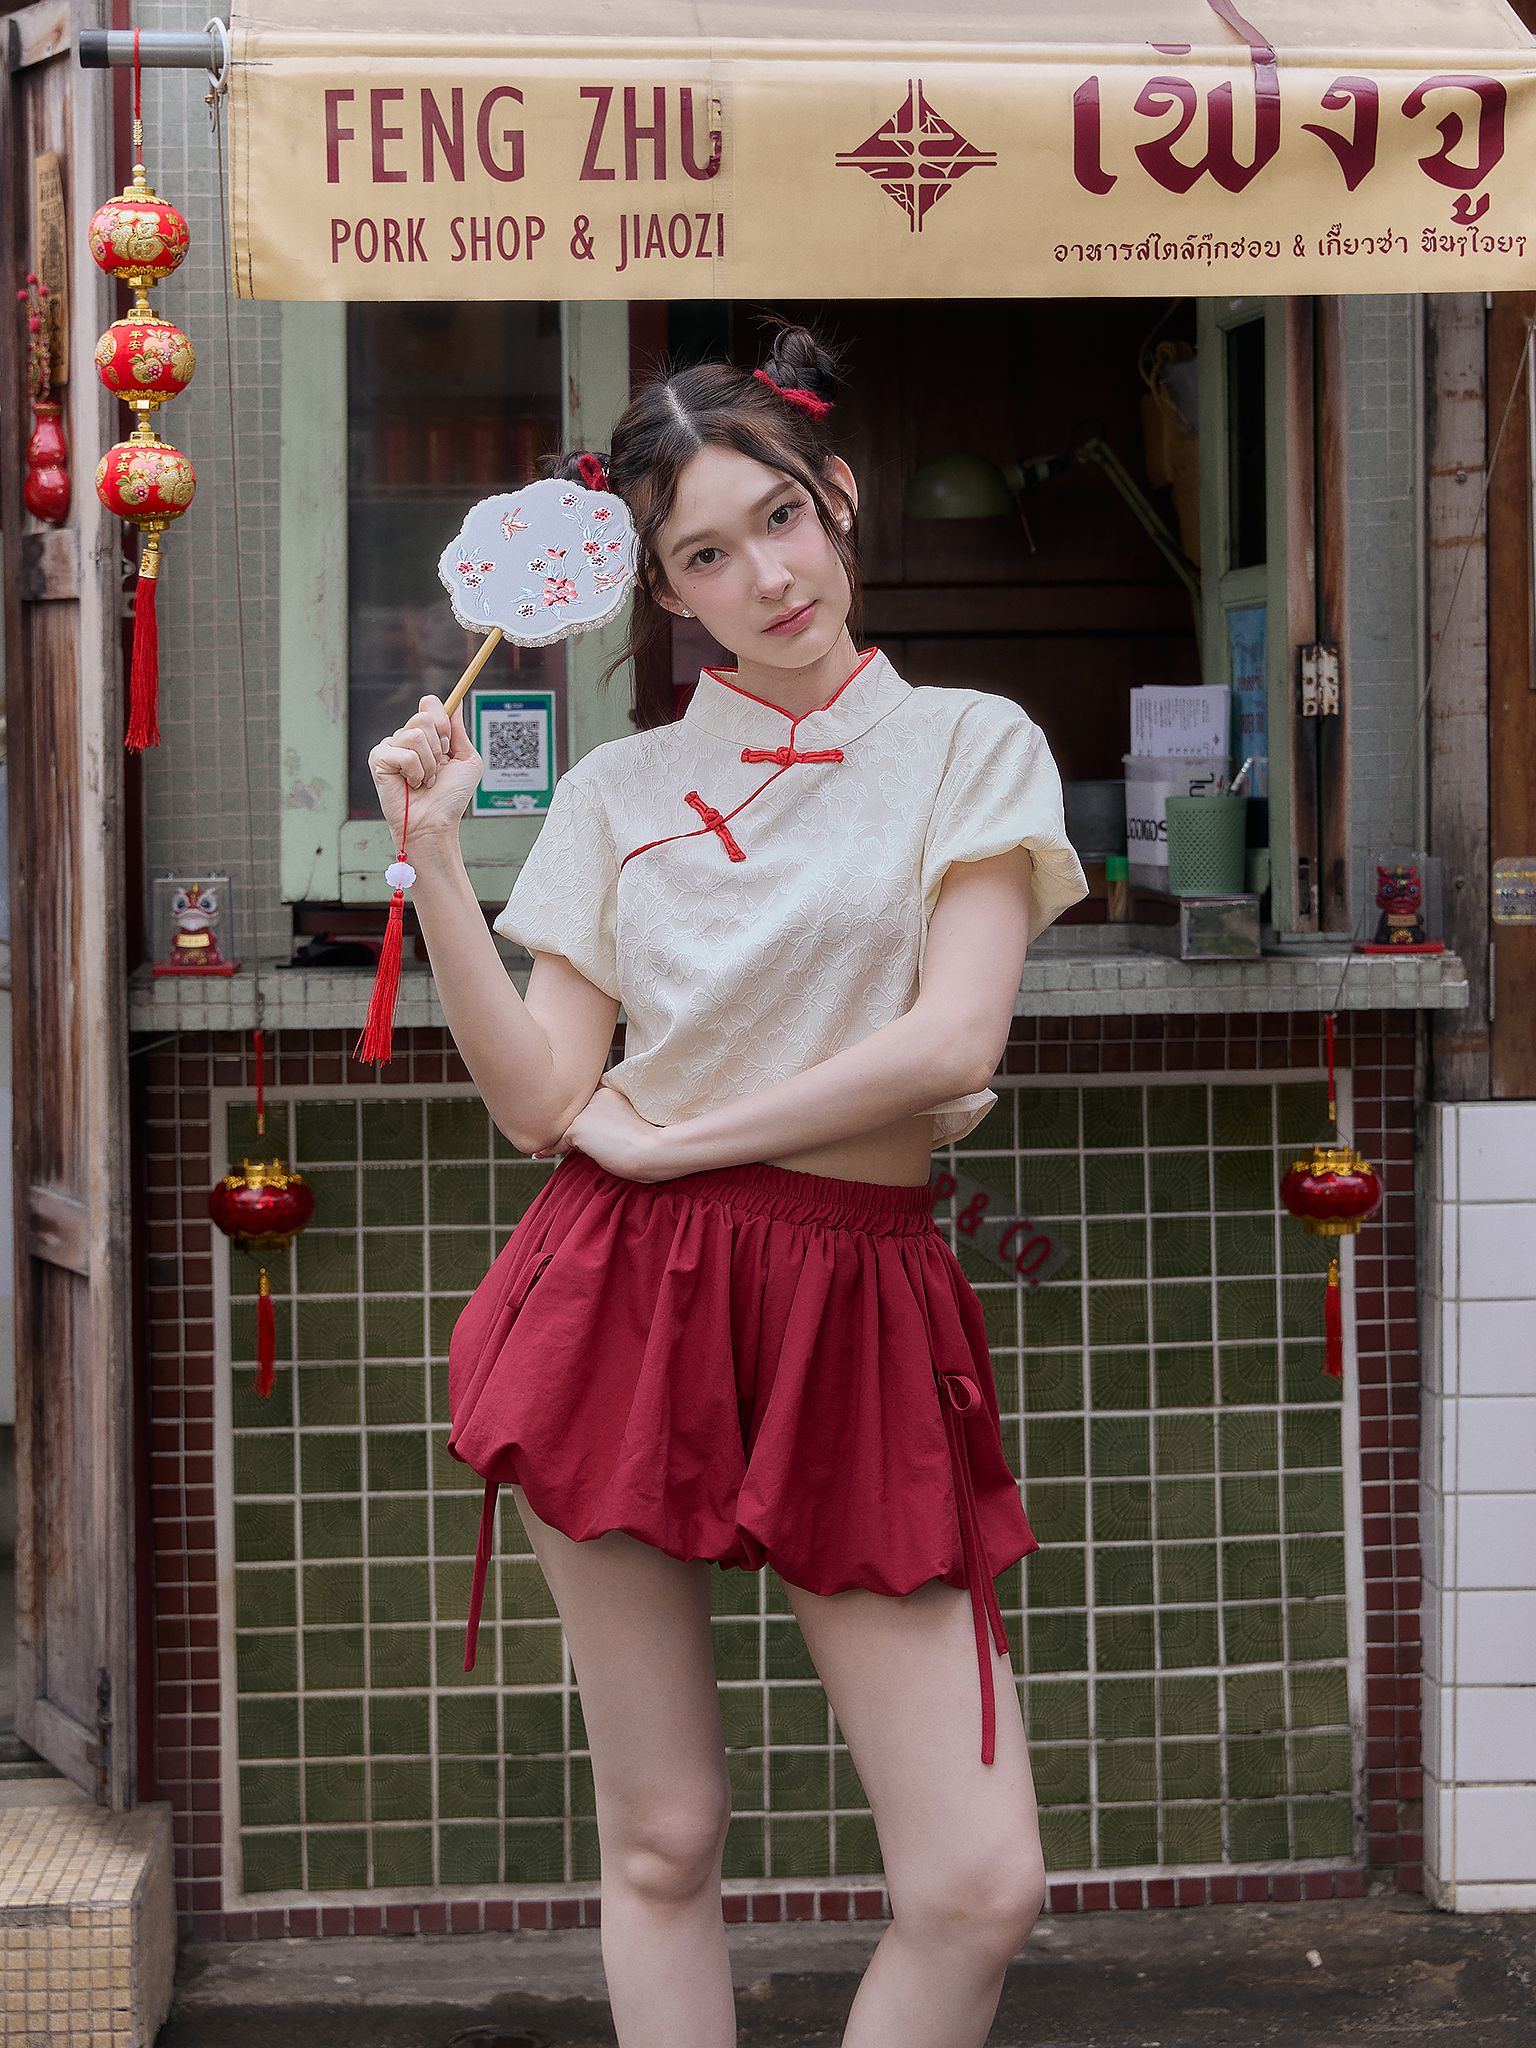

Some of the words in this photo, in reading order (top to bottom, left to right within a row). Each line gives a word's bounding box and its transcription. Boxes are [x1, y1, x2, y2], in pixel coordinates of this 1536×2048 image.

[324, 85, 526, 184] FENG
[578, 85, 722, 181] ZHU
[330, 217, 429, 264] PORK
[450, 215, 546, 262] SHOP
[570, 214, 595, 260] &
[615, 212, 725, 272] JIAOZI
[1292, 234, 1306, 257] &
[956, 1191, 990, 1239] &
[998, 1220, 1053, 1287] CO.
